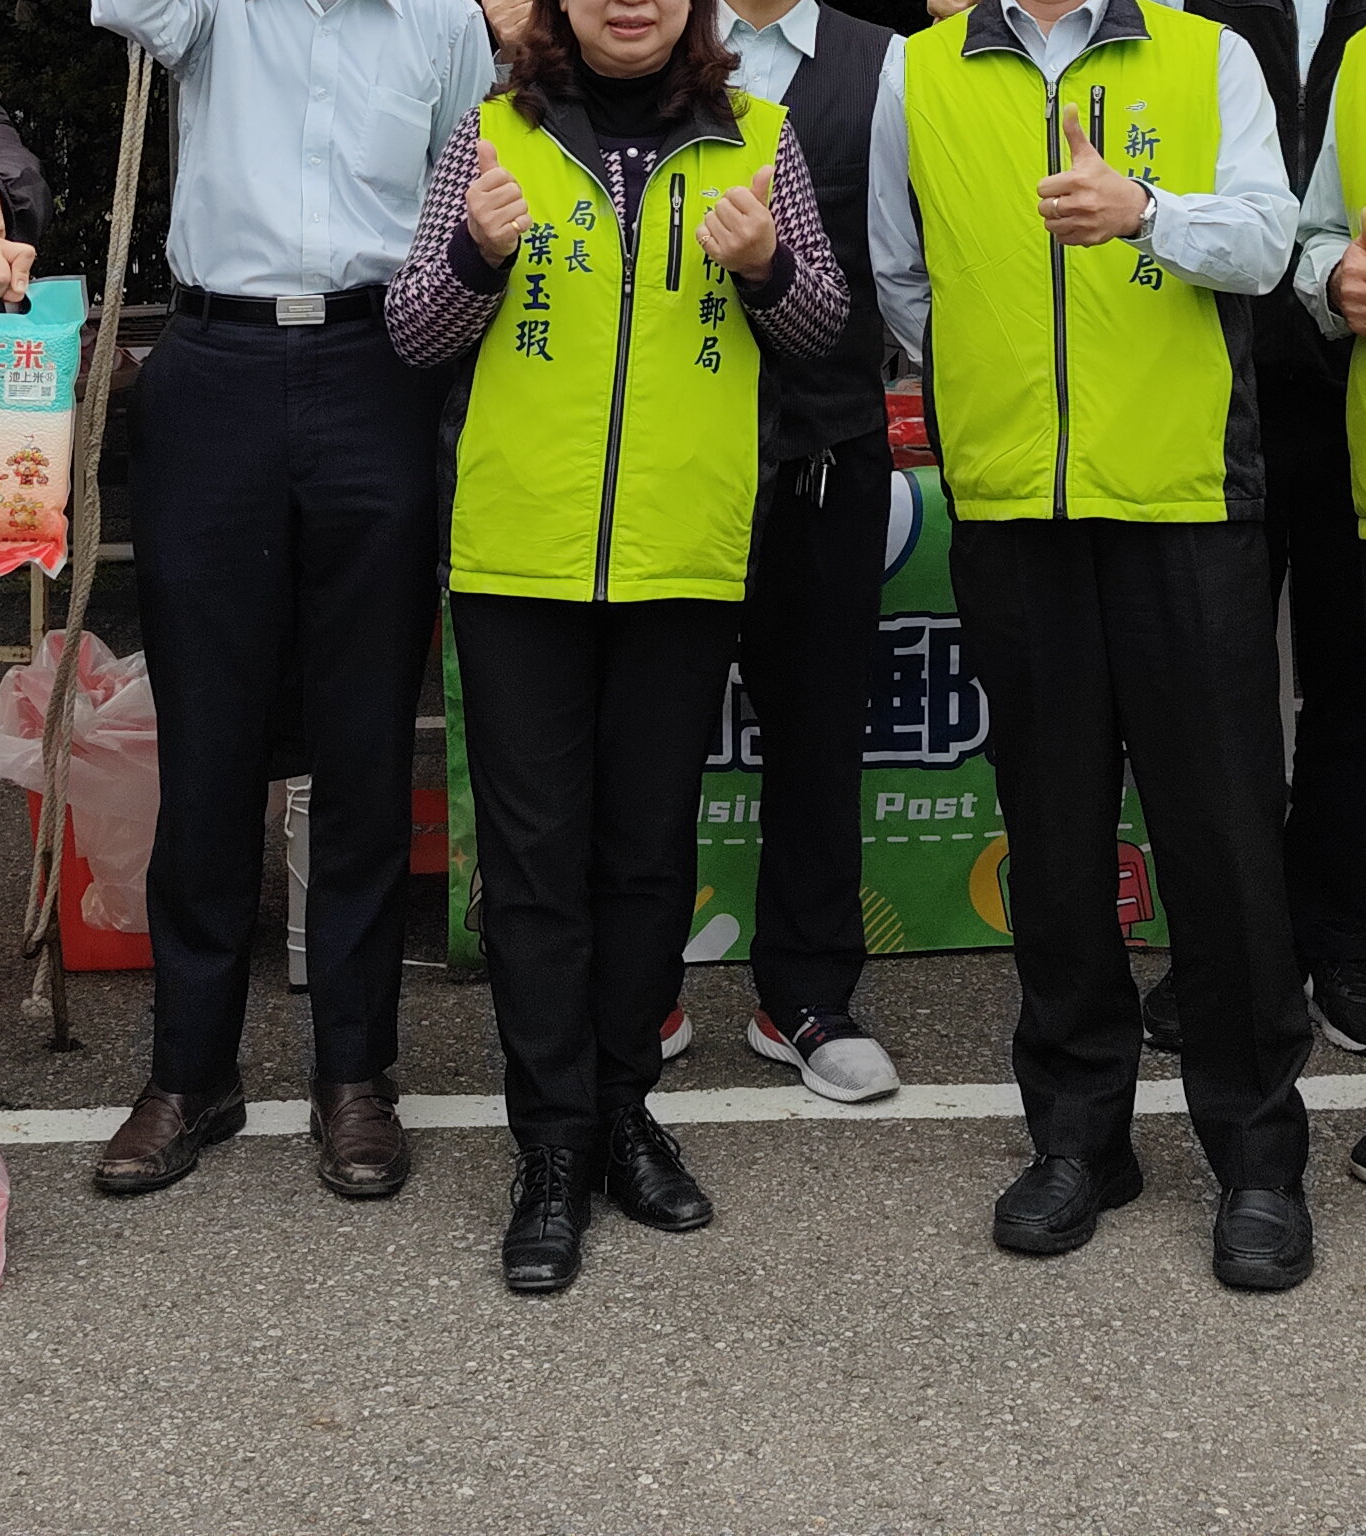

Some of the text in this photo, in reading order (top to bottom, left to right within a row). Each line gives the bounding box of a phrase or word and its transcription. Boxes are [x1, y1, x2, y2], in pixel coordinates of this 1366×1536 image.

[564, 200, 597, 273] 局長
[515, 222, 560, 362] 葉玉瑕
[694, 206, 730, 375] 竹郵局
[875, 791, 979, 821] Post
